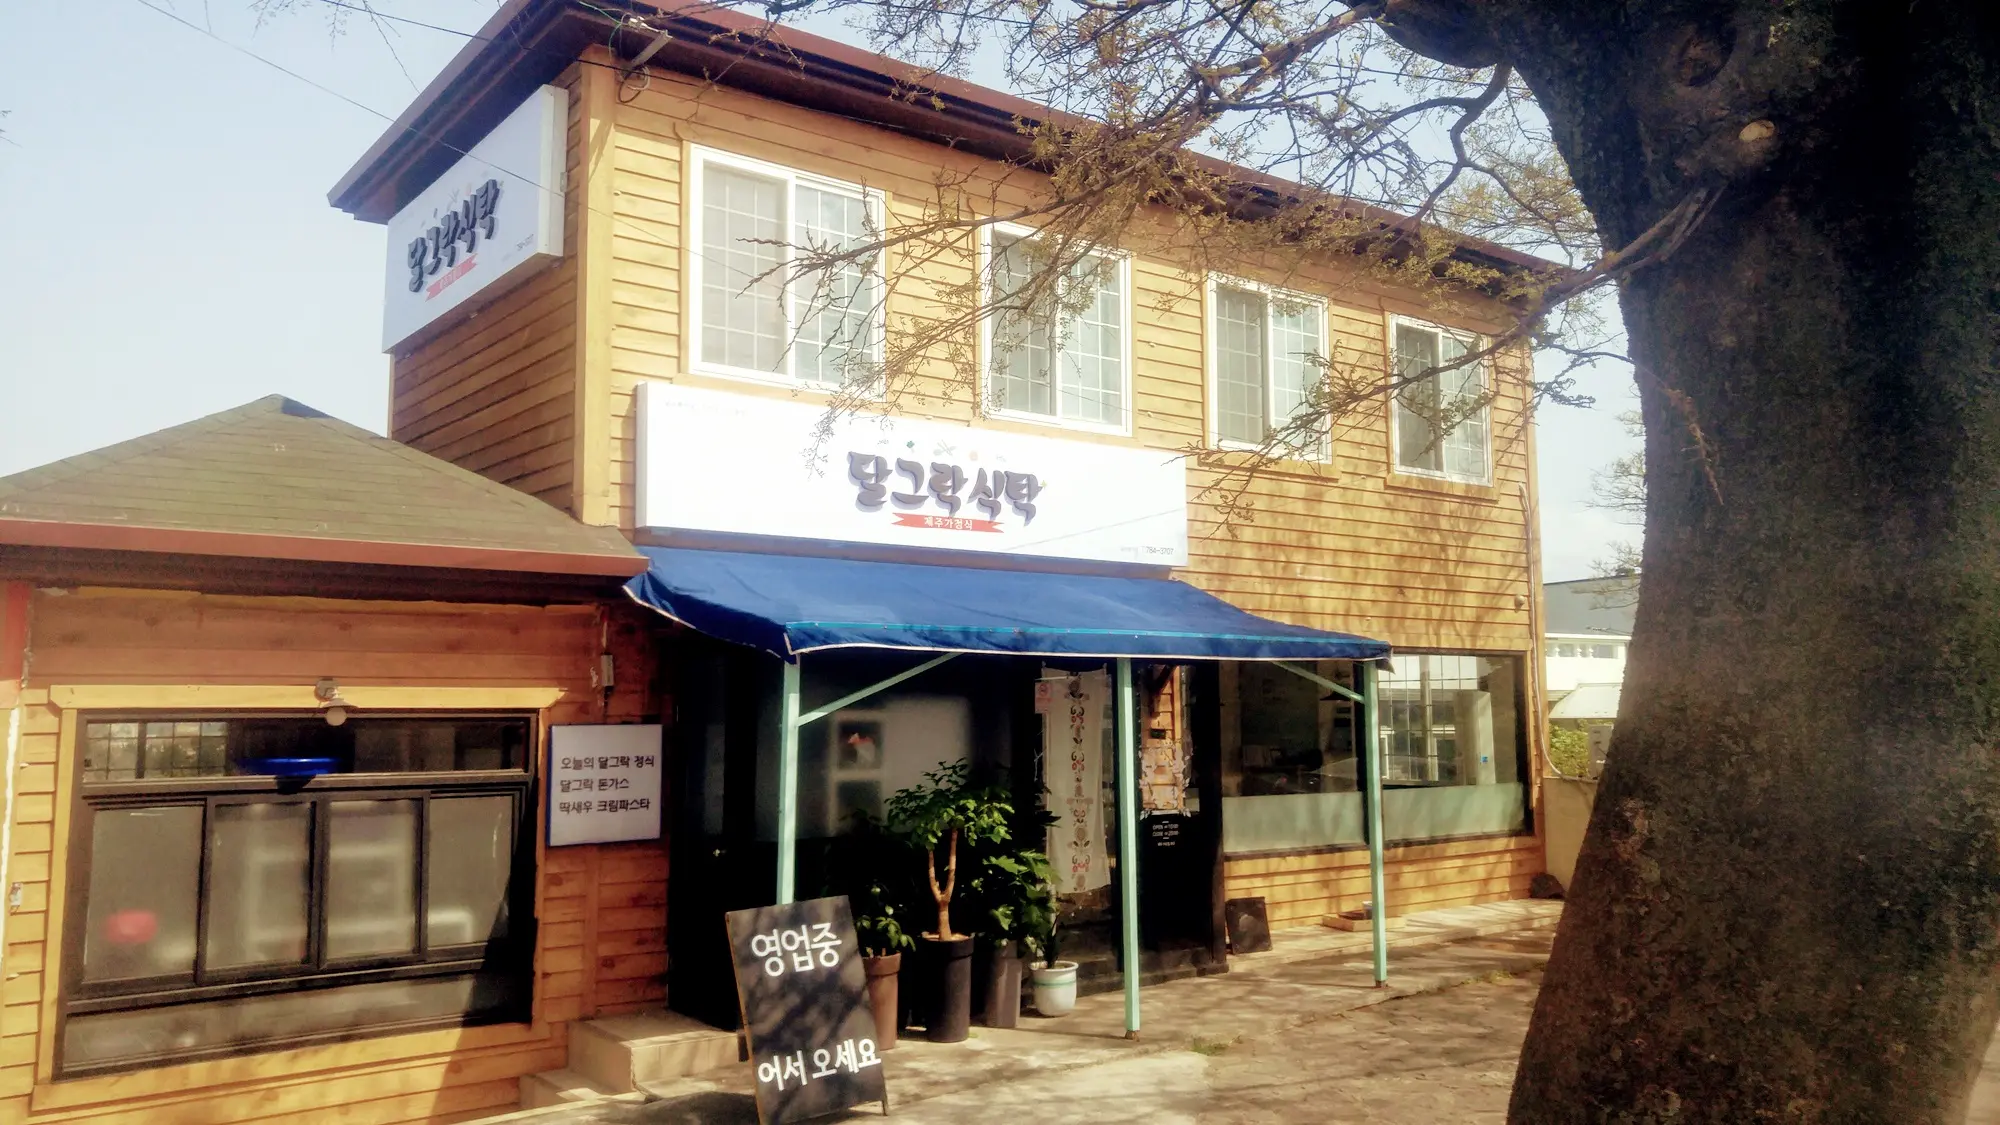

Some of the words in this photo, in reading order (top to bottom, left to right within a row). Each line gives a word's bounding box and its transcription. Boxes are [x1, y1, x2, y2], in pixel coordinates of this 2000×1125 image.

[924, 516, 973, 531] 제주가정식
[561, 757, 594, 770] 오늘의
[598, 756, 630, 769] 달그락
[634, 755, 655, 768] 정식
[560, 779, 594, 792] 달그락
[598, 778, 629, 791] 돈가스
[560, 801, 592, 814] 딱새우
[597, 798, 650, 812] 크림파스타
[752, 922, 842, 976] 영업중
[758, 1051, 808, 1091] 어서
[812, 1039, 881, 1079] 오세요
